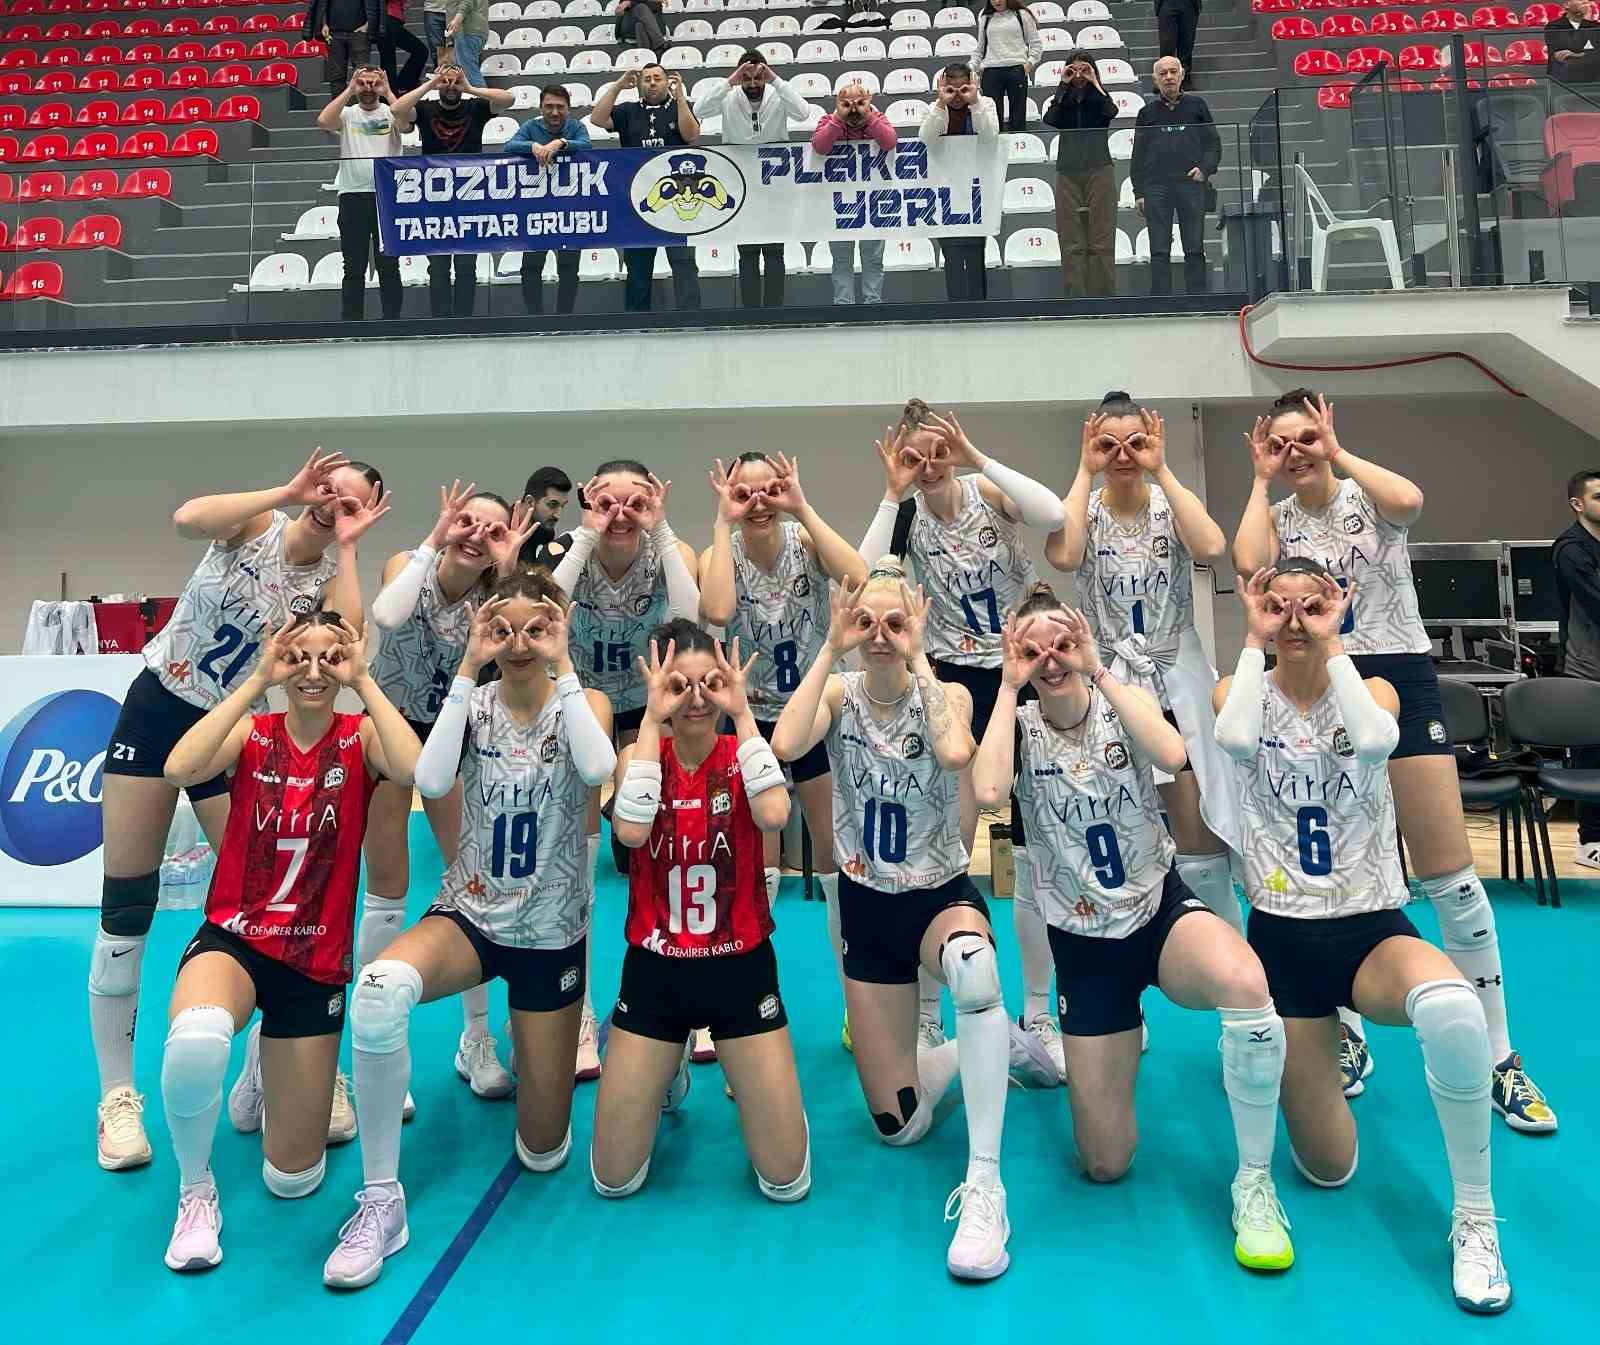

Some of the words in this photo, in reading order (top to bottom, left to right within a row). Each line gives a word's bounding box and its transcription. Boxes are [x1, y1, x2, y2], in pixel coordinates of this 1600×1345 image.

[1082, 7, 1093, 15] 15
[906, 15, 916, 23] 11
[1045, 34, 1056, 42] 14
[906, 42, 916, 50] 11
[951, 39, 961, 47] 12
[816, 46, 822, 54] 9
[858, 45, 868, 53] 10
[1314, 59, 1321, 67] 1
[1366, 58, 1373, 67] 2
[1106, 66, 1118, 74] 15
[143, 76, 153, 85] 13
[187, 74, 198, 83] 14
[903, 73, 913, 82] 11
[8, 83, 19, 91] 10
[807, 79, 813, 88] 9
[1339, 93, 1345, 102] 1
[143, 109, 154, 117] 14
[188, 106, 199, 115] 15
[239, 104, 249, 113] 16
[905, 107, 915, 116] 11
[3, 113, 14, 121] 11
[49, 112, 59, 120] 12
[97, 111, 107, 119] 13
[95, 143, 106, 151] 14
[1014, 141, 1026, 150] 13
[44, 147, 55, 155] 13
[146, 180, 158, 189] 16
[394, 156, 610, 204] BOZÜYÜK
[41, 184, 52, 193] 14
[92, 182, 103, 191] 15
[1021, 185, 1034, 195] 13
[395, 212, 519, 241] TARAFTAR
[526, 210, 608, 237] GRUBU
[33, 232, 46, 241] 15
[92, 230, 105, 240] 16
[898, 242, 912, 252] 11
[1028, 237, 1042, 248] 13
[590, 252, 598, 261] 6
[711, 249, 719, 258] 8
[405, 257, 412, 267] 3
[31, 279, 45, 289] 16
[960, 587, 1002, 636] 17
[1132, 599, 1145, 636] 1
[197, 623, 260, 690] 21
[773, 639, 801, 693] 8
[113, 742, 136, 761] 21
[863, 797, 908, 864] 10
[491, 811, 538, 879] 19
[1296, 805, 1333, 877] 6
[1085, 823, 1126, 890] 9
[265, 836, 310, 912] 7
[668, 863, 717, 935] 13
[293, 924, 327, 936] KABLO
[711, 938, 744, 956] KABLO
[1059, 994, 1067, 1015] 9
